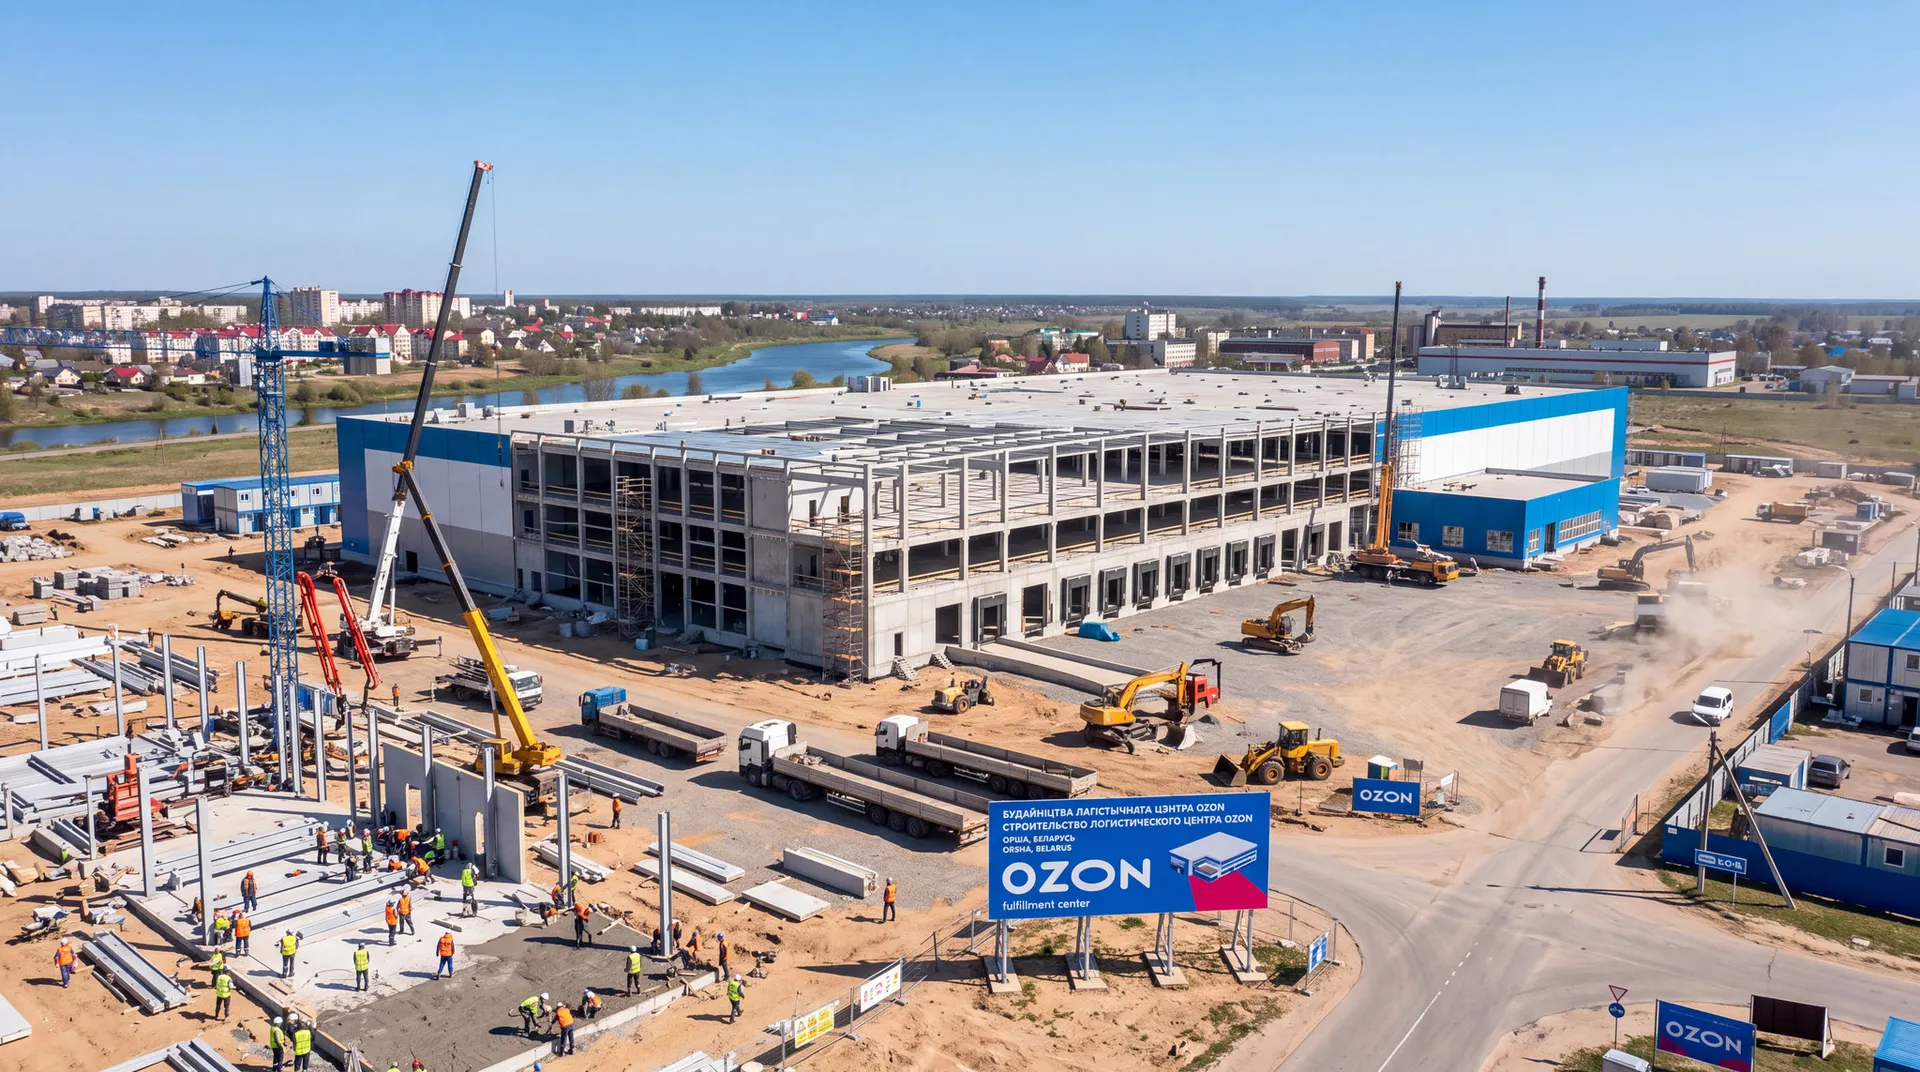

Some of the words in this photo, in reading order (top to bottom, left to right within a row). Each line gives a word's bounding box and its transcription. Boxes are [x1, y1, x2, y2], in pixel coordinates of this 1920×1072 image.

[1360, 789, 1413, 804] OZON
[1003, 807, 1074, 820] БУДАЙНІЦТВА
[1075, 805, 1153, 817] ЛАГІСТЫЧНАТА
[1154, 803, 1194, 815] ЦЭНТРА
[1196, 803, 1225, 812] OZON
[1002, 820, 1088, 832] СТРОИТЕЛЬСТВО
[1090, 816, 1181, 829] ЛОГИСТИЧЕСКОГО
[1183, 815, 1223, 827] ЦЕНТРА
[1224, 814, 1253, 824] OZON
[1002, 836, 1031, 844] ОРША,
[1033, 834, 1076, 843] БЕЛАРУСЬ
[1002, 845, 1033, 853] ORSHA,
[1035, 844, 1072, 852] BELARUS
[1002, 858, 1151, 895] OZON
[1002, 900, 1055, 911] fulfillment
[1057, 899, 1091, 908] center
[1665, 1020, 1742, 1055] OZON
